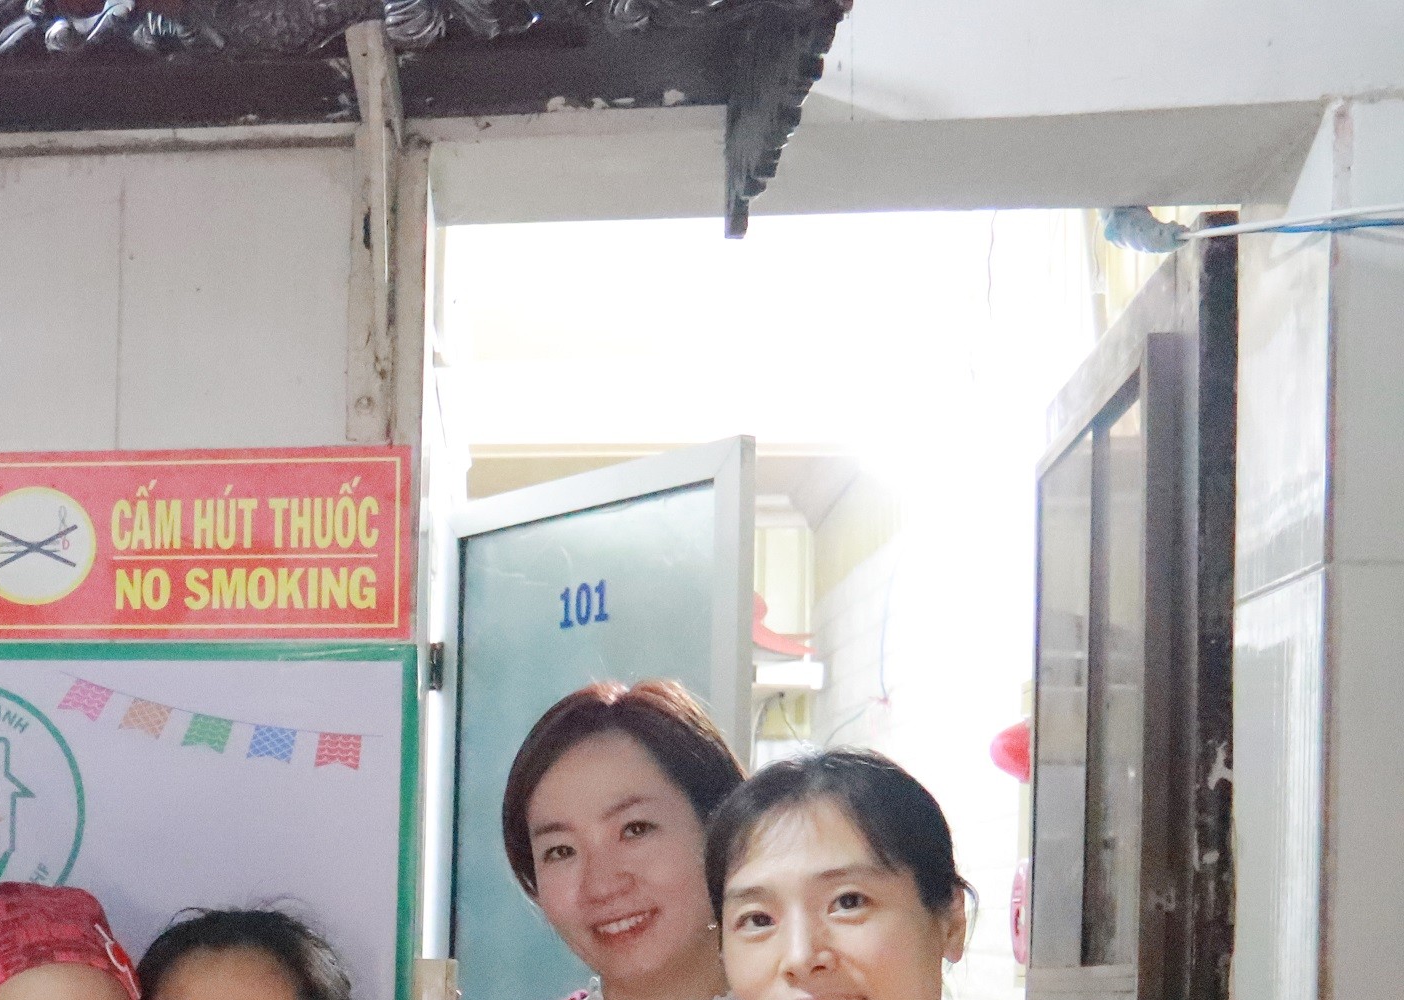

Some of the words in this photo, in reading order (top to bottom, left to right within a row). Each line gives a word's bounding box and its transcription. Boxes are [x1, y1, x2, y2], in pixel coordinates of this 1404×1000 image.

[111, 479, 182, 550] CẤM
[193, 484, 258, 550] HÚT
[268, 475, 380, 549] THUỐC
[115, 567, 172, 611] NO
[184, 566, 378, 610] SMOKING
[559, 579, 610, 629] 101
